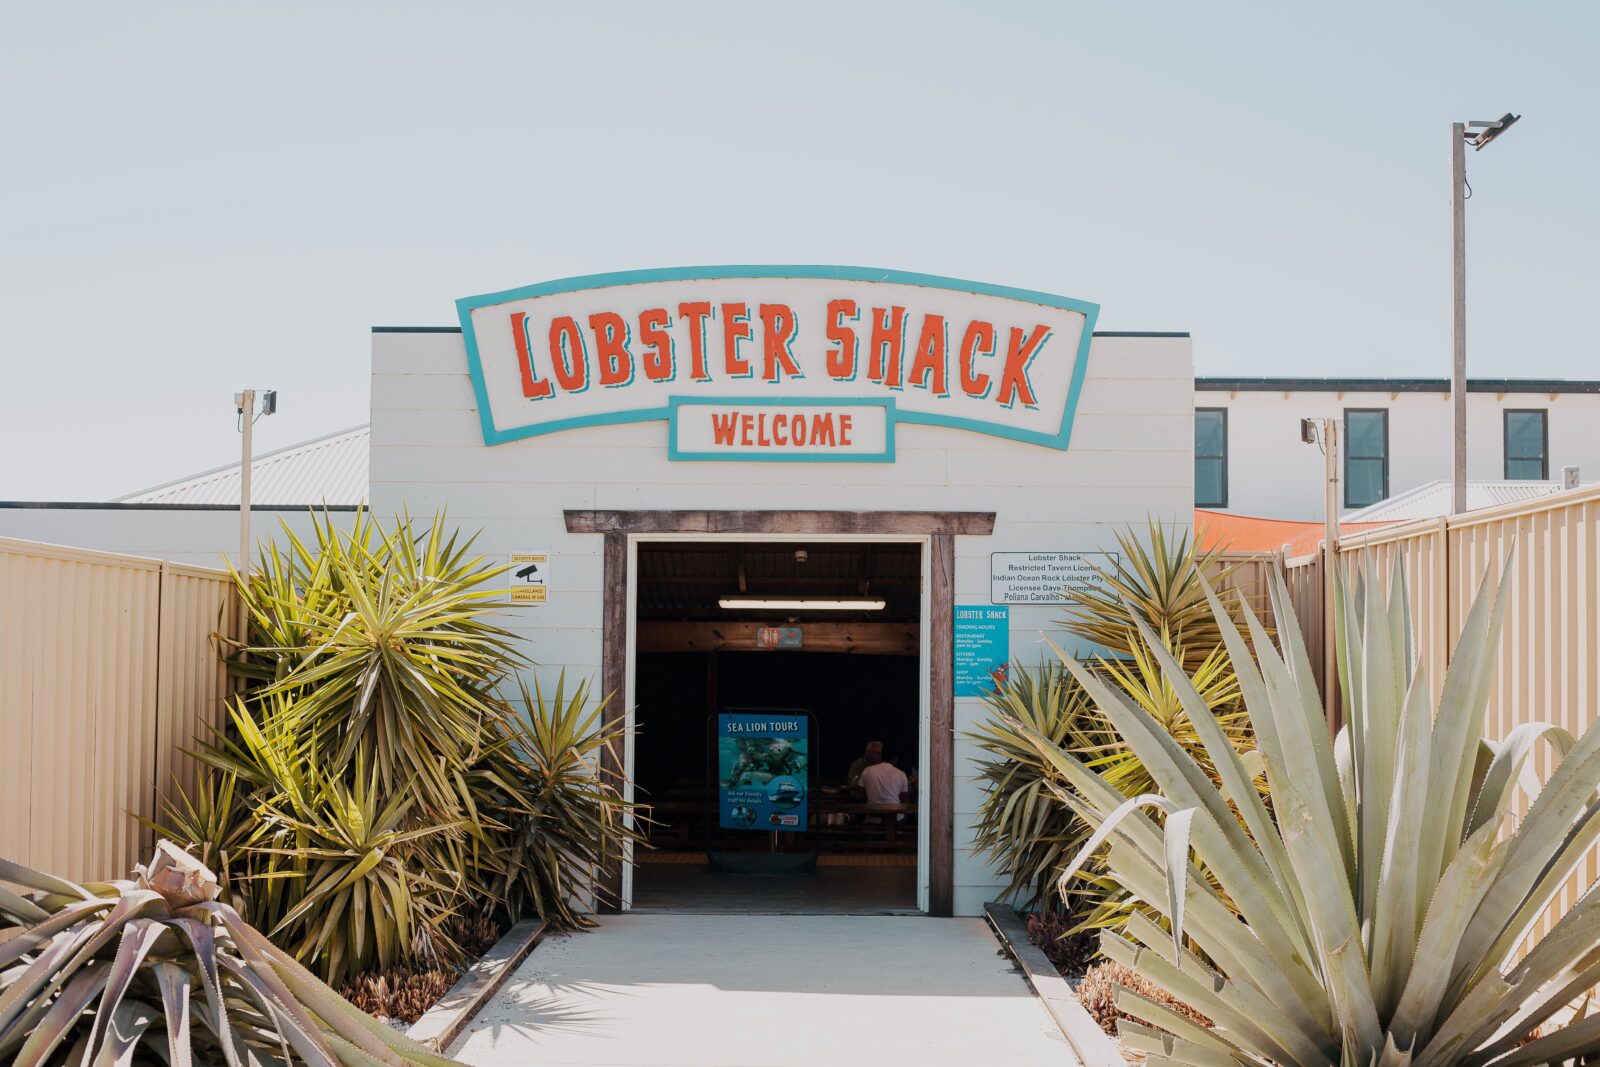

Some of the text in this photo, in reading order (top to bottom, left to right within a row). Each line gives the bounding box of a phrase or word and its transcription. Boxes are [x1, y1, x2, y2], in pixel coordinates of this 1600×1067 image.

[511, 299, 1055, 411] LOBSTER SHACK
[712, 412, 853, 447] WELCOME
[1028, 554, 1081, 562] Lobster Shack
[1008, 564, 1046, 572] Restricted
[1047, 564, 1072, 572] Tavern
[993, 574, 1016, 582] Indian
[1017, 574, 1040, 582] Ocean
[1041, 574, 1060, 582] Rock
[1062, 574, 1090, 582] Lobster
[1091, 574, 1103, 583] Pty
[1004, 593, 1029, 601] Poliana
[1030, 593, 1060, 601] Carvalho
[956, 610, 1007, 619] LOBSTER SHACK
[727, 721, 798, 732] SEA LION TOURS
